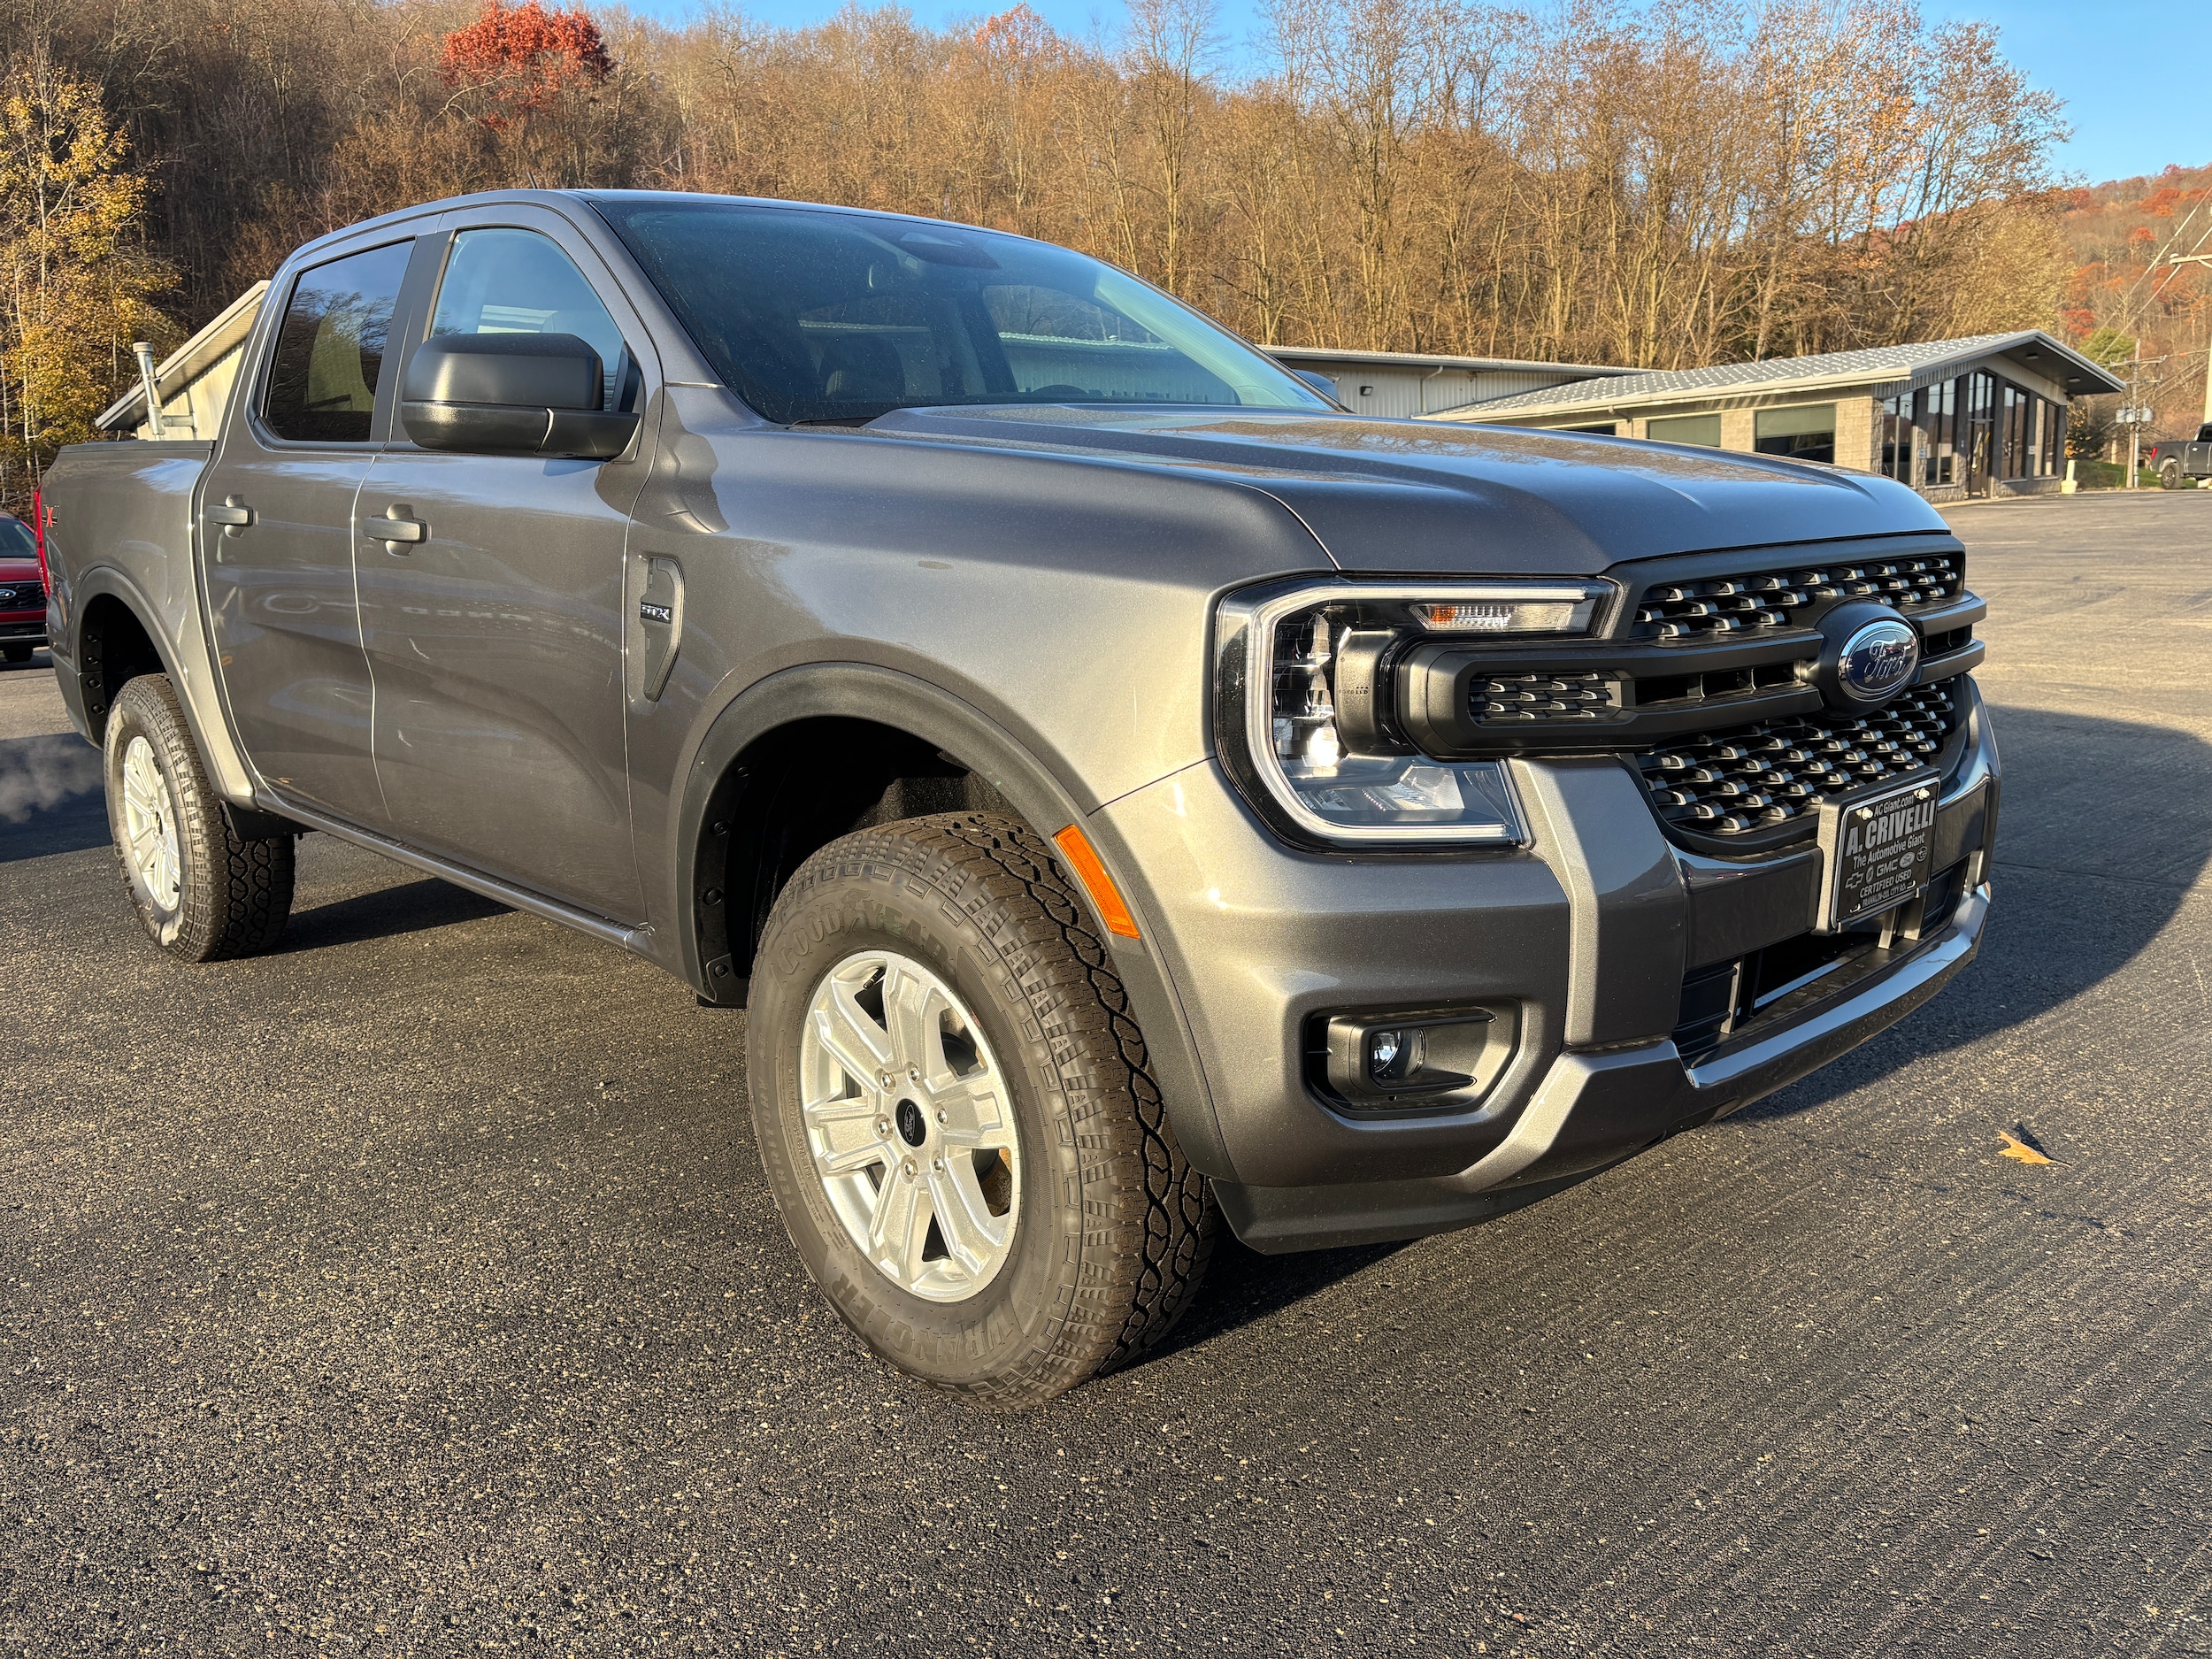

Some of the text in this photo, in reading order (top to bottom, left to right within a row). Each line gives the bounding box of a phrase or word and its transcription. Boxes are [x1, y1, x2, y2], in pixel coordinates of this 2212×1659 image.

[1864, 639, 1911, 684] Ford
[1846, 800, 1935, 856] A. CRIVELLI
[1854, 832, 1925, 870] The Automotive Giant
[1877, 859, 1899, 877] GMC
[1860, 869, 1912, 898] CERTIFIED USED
[776, 894, 949, 974] GOODYEAR
[758, 1033, 768, 1063] AT
[758, 1076, 795, 1210] TERRITORY
[803, 1164, 812, 1179] TIRE
[831, 1273, 1014, 1365] WRANGLER
